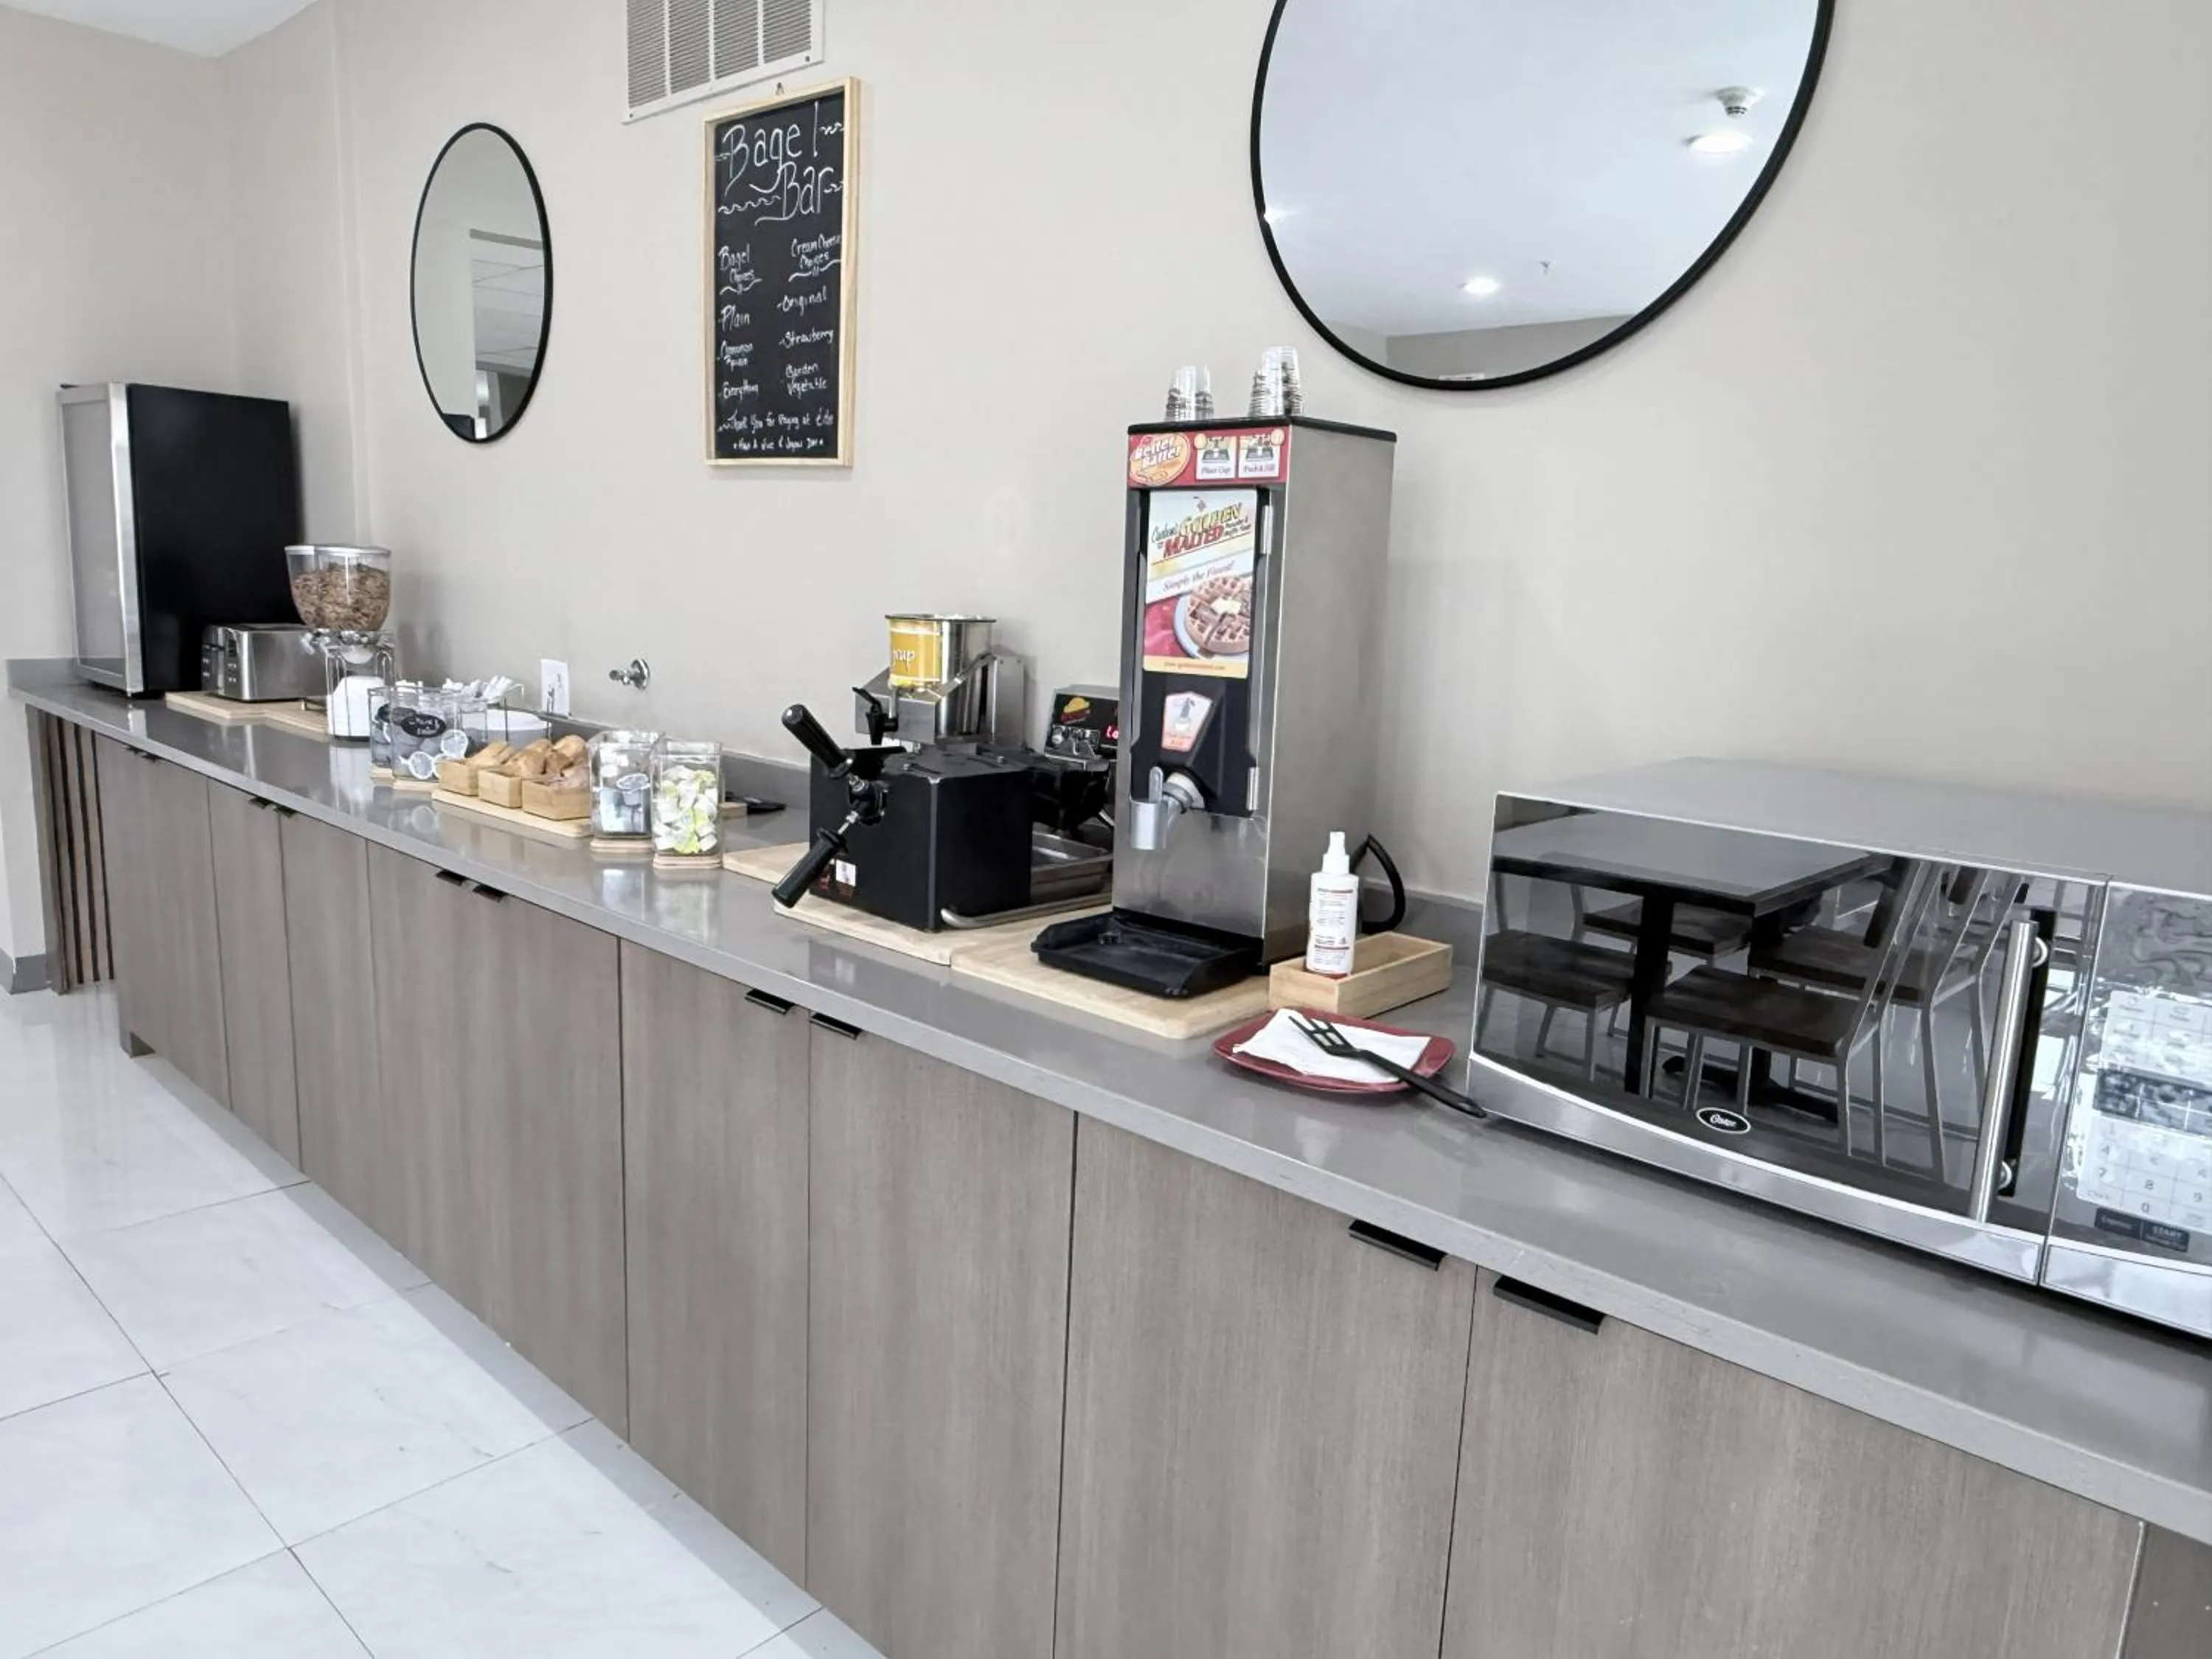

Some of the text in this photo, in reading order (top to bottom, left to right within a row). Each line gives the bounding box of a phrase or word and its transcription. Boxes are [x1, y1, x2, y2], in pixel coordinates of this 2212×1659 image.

[722, 101, 819, 197] Bagel
[754, 161, 834, 226] Bar
[717, 243, 750, 271] Bagel
[1164, 524, 1225, 558] MALTED
